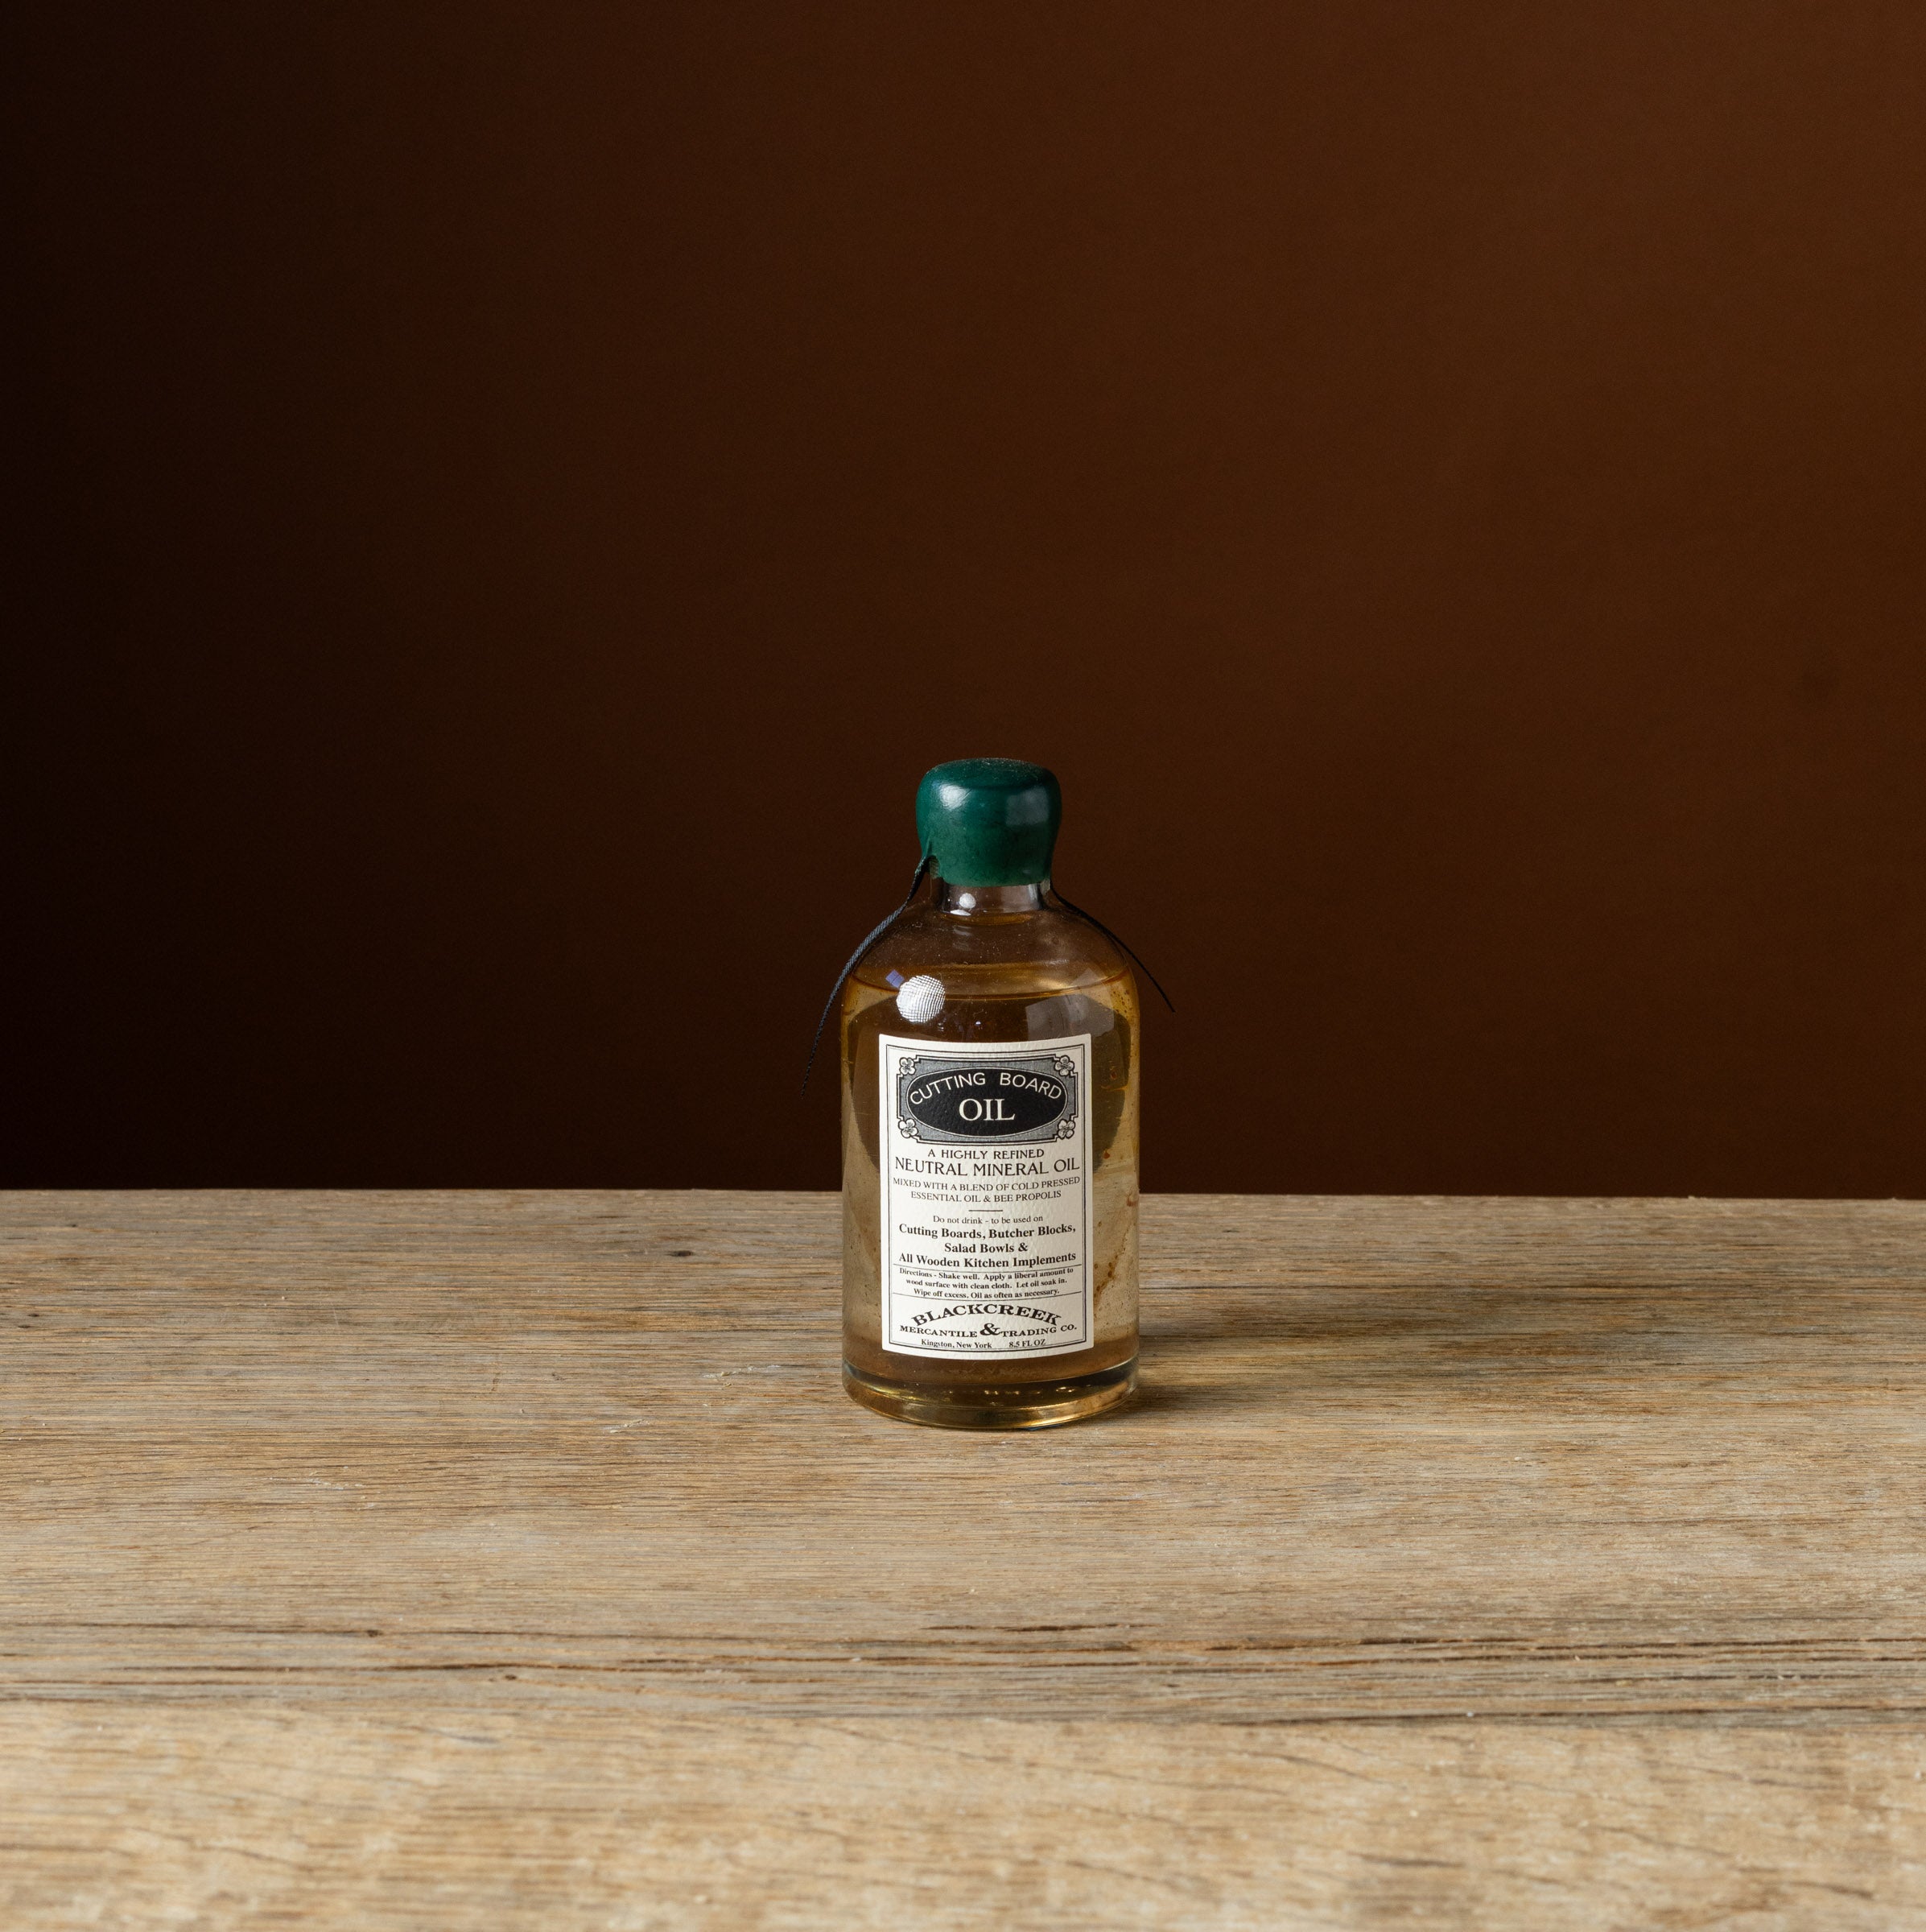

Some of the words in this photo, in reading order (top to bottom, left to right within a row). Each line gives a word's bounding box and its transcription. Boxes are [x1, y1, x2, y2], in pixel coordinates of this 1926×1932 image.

[909, 1072, 986, 1104] CUTTING
[1000, 1072, 1062, 1100] BOARD
[959, 1098, 1016, 1121] OIL
[927, 1149, 935, 1158] A
[942, 1150, 988, 1159] HIGHLY
[994, 1149, 1044, 1159] REFINED
[895, 1157, 967, 1176] NEUTRAL
[973, 1162, 1049, 1177] MINERAL
[1054, 1158, 1080, 1173] OIL
[893, 1178, 921, 1188] MIXED
[924, 1182, 947, 1190] WITH
[959, 1183, 994, 1191] BLEND
[996, 1183, 1009, 1191] OF
[1012, 1182, 1039, 1191] COLD
[1041, 1176, 1080, 1188] PRESSED
[911, 1191, 962, 1202] ESSENTIAL
[963, 1195, 981, 1203] OIL
[1016, 1190, 1062, 1202] PROPOLIS
[899, 1224, 938, 1239] Cutting
[942, 1228, 986, 1240] Boards,
[988, 1228, 1035, 1239] Butcher
[1037, 1224, 1076, 1236] Blocks,
[944, 1243, 976, 1253] Salad
[980, 1243, 1014, 1253] Bowls
[1018, 1242, 1028, 1253] &
[899, 1253, 913, 1263] All
[916, 1255, 960, 1268] Wooden
[964, 1258, 1009, 1268] Kitchen
[1013, 1252, 1076, 1267] Implements
[899, 1267, 933, 1278] Directions
[938, 1272, 961, 1280] Shake
[984, 1273, 1006, 1282] Apply
[1014, 1271, 1037, 1279] liberal
[1040, 1268, 1066, 1277] amount
[906, 1278, 923, 1286] wood
[914, 1288, 931, 1298] Wipe
[1025, 1289, 1060, 1297] necessary.
[911, 1303, 1062, 1326] BLACKCREEK
[900, 1325, 978, 1338] MERCANTILE
[979, 1323, 1001, 1336] &
[1000, 1325, 1057, 1338] TRADING
[1060, 1323, 1077, 1332] CO.
[922, 1339, 955, 1348] Kingston,
[975, 1341, 992, 1349] York
